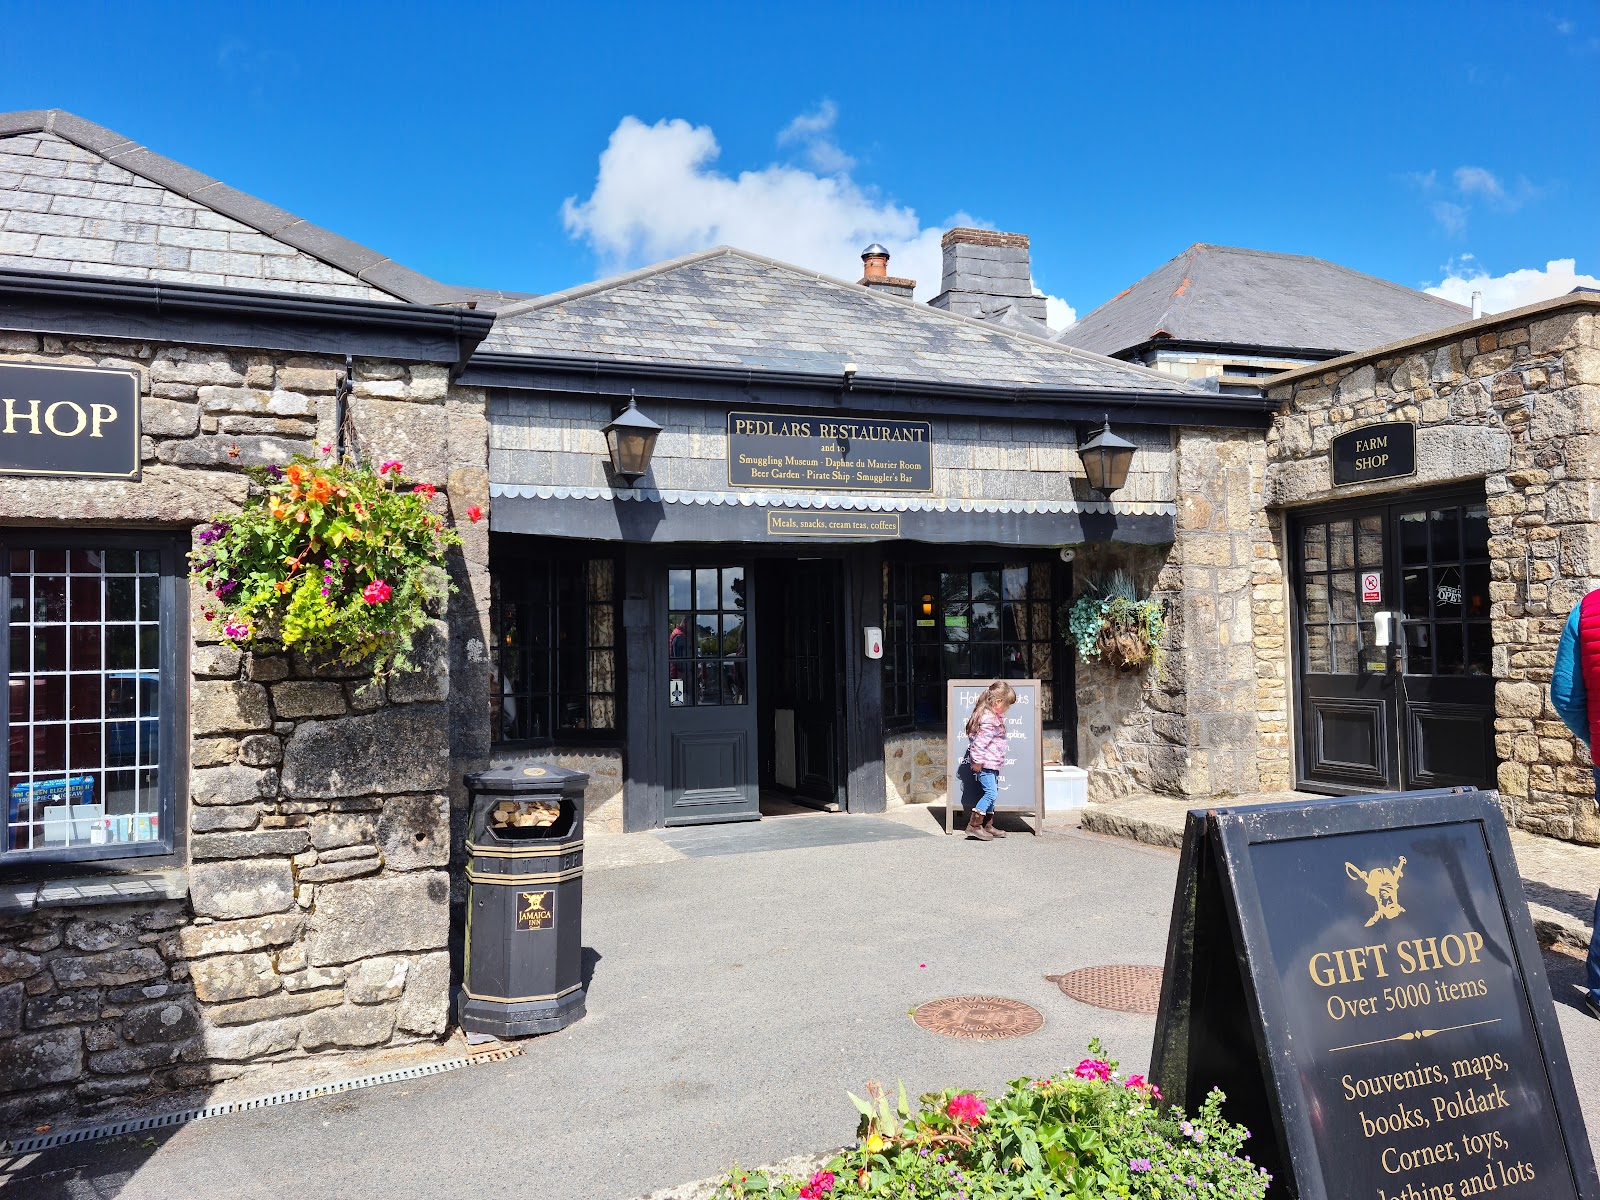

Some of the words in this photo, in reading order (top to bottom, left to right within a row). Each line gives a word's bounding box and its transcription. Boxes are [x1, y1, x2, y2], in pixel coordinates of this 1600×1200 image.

[735, 419, 810, 438] PEDLARS
[819, 423, 925, 443] RESTAURANT
[820, 443, 835, 452] and
[837, 444, 846, 452] to
[1355, 435, 1388, 453] FARM
[739, 453, 783, 467] Smuggling
[785, 455, 818, 466] Museum
[825, 457, 854, 470] Daphne
[855, 459, 865, 468] du
[867, 459, 898, 469] Maurier
[899, 460, 922, 470] Room
[1355, 453, 1389, 471] SHOP
[751, 467, 769, 478] Beer
[771, 468, 800, 479] Garden
[806, 469, 830, 480] Pirate
[831, 470, 850, 483] Ship
[856, 471, 898, 483] Smuggler's
[900, 472, 913, 482] Bar
[828, 521, 851, 529] cream
[870, 520, 897, 530] coffees
[1008, 715, 1023, 725] and
[518, 910, 551, 923] JAMAICA
[1308, 943, 1388, 987] GIFT
[1397, 931, 1484, 975] SHOP
[1327, 995, 1378, 1021] Over
[1383, 982, 1431, 1012] 5000
[1434, 977, 1488, 1003] items
[1341, 1062, 1449, 1101] Souvenirs,
[1452, 1052, 1509, 1083] maps,
[1359, 1103, 1430, 1138] books,
[1431, 1083, 1510, 1124] Poldark
[1381, 1141, 1460, 1175] Corner,
[1462, 1130, 1509, 1159] toys,
[1459, 1163, 1497, 1198] and
[1497, 1160, 1535, 1187] lots
